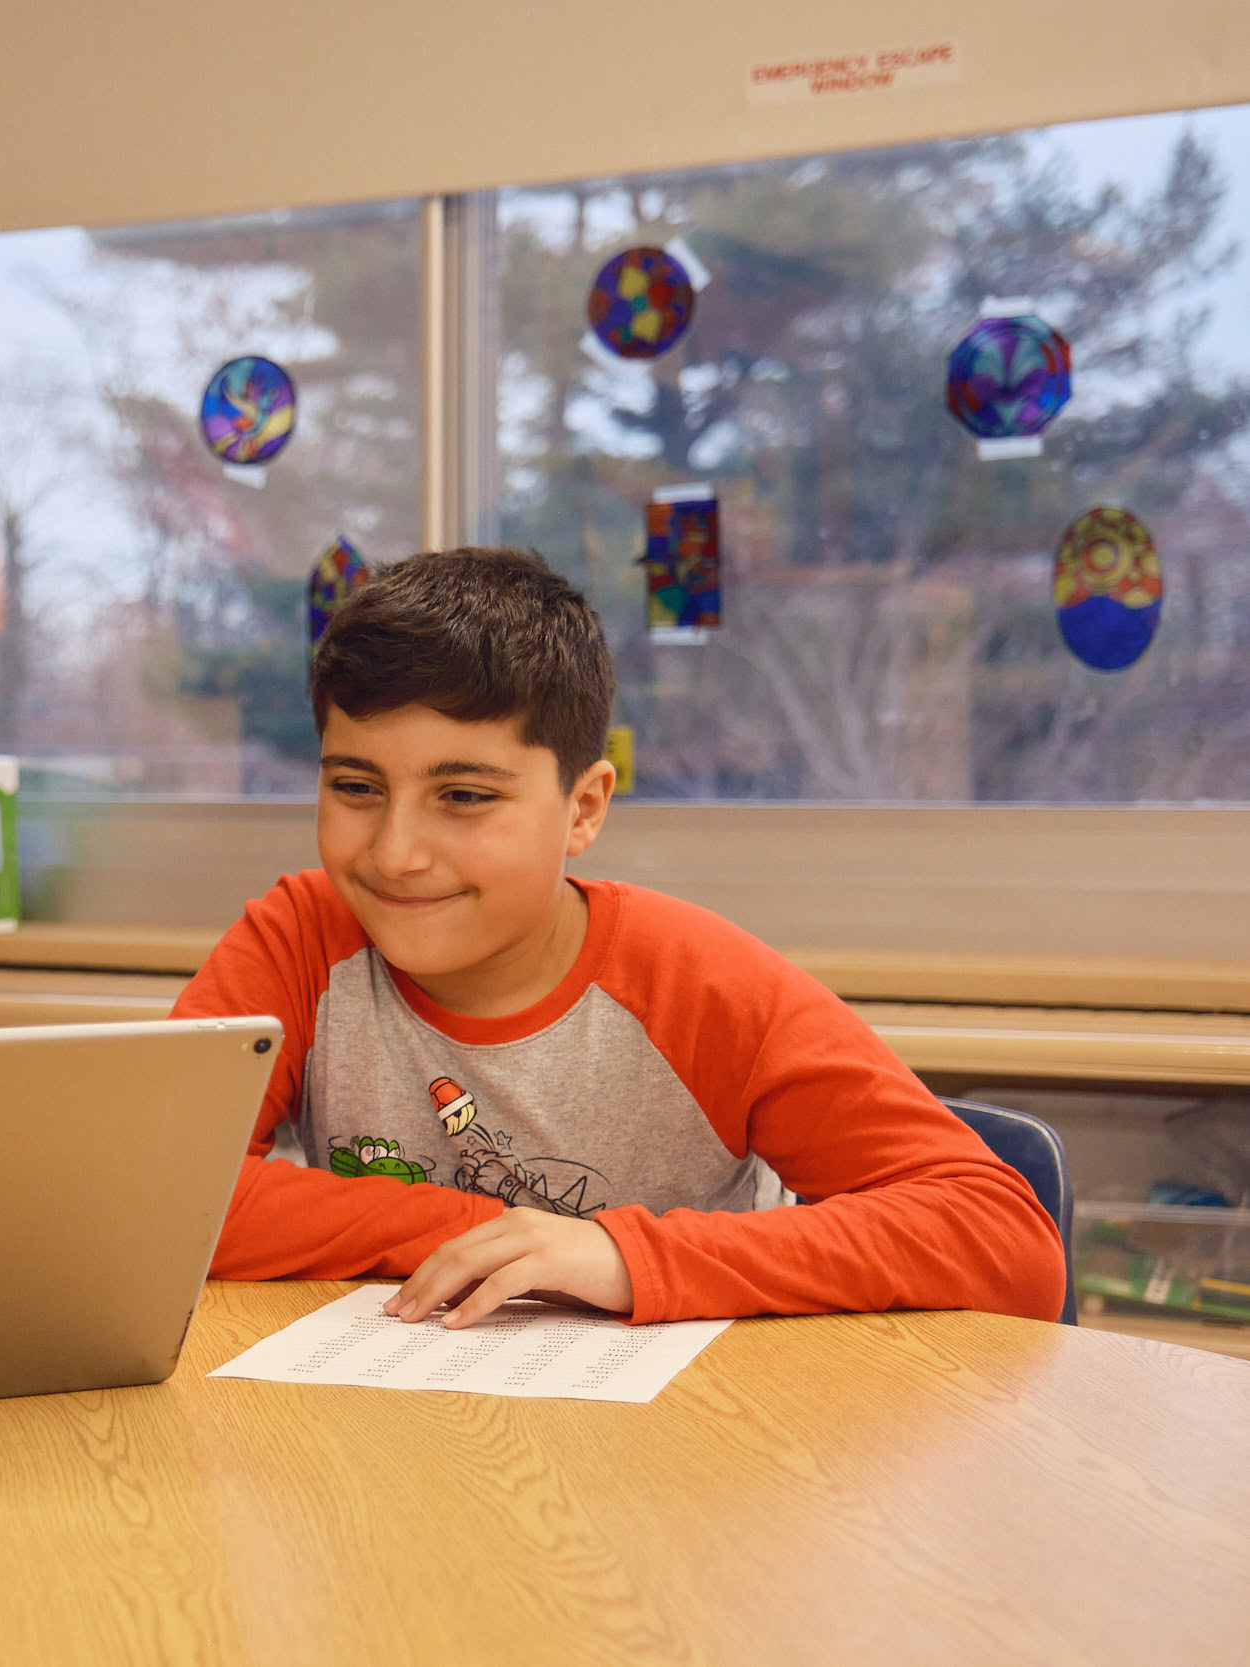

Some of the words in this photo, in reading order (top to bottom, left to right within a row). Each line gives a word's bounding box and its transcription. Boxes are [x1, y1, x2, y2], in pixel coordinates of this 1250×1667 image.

[751, 54, 870, 84] EMERGENCY
[876, 43, 953, 69] ESCAPE
[810, 69, 894, 94] WINDOW
